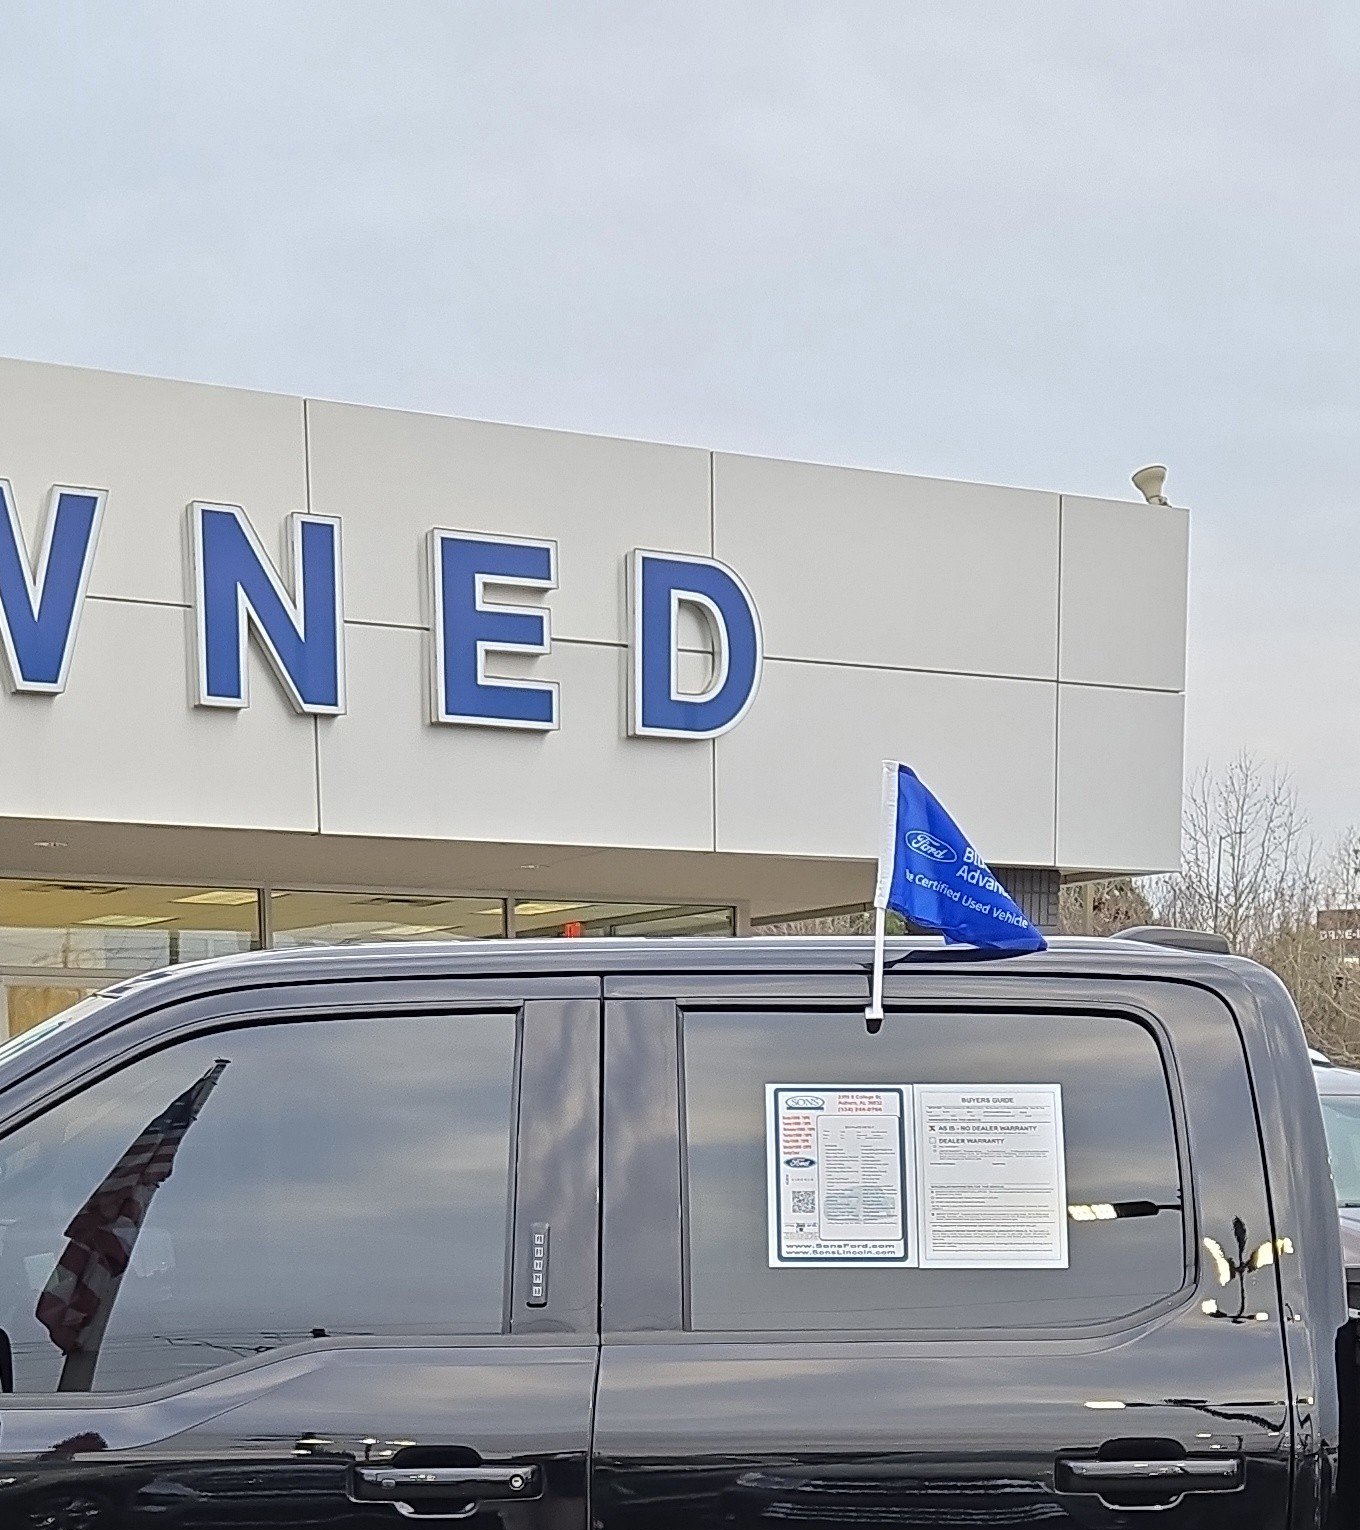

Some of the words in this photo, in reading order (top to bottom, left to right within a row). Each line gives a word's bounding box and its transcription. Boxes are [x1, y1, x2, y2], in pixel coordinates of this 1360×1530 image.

[911, 833, 949, 859] Ford
[915, 874, 961, 902] Certified
[962, 894, 991, 915] Used
[993, 907, 1029, 929] Vehicle
[790, 1098, 821, 1107] SONS
